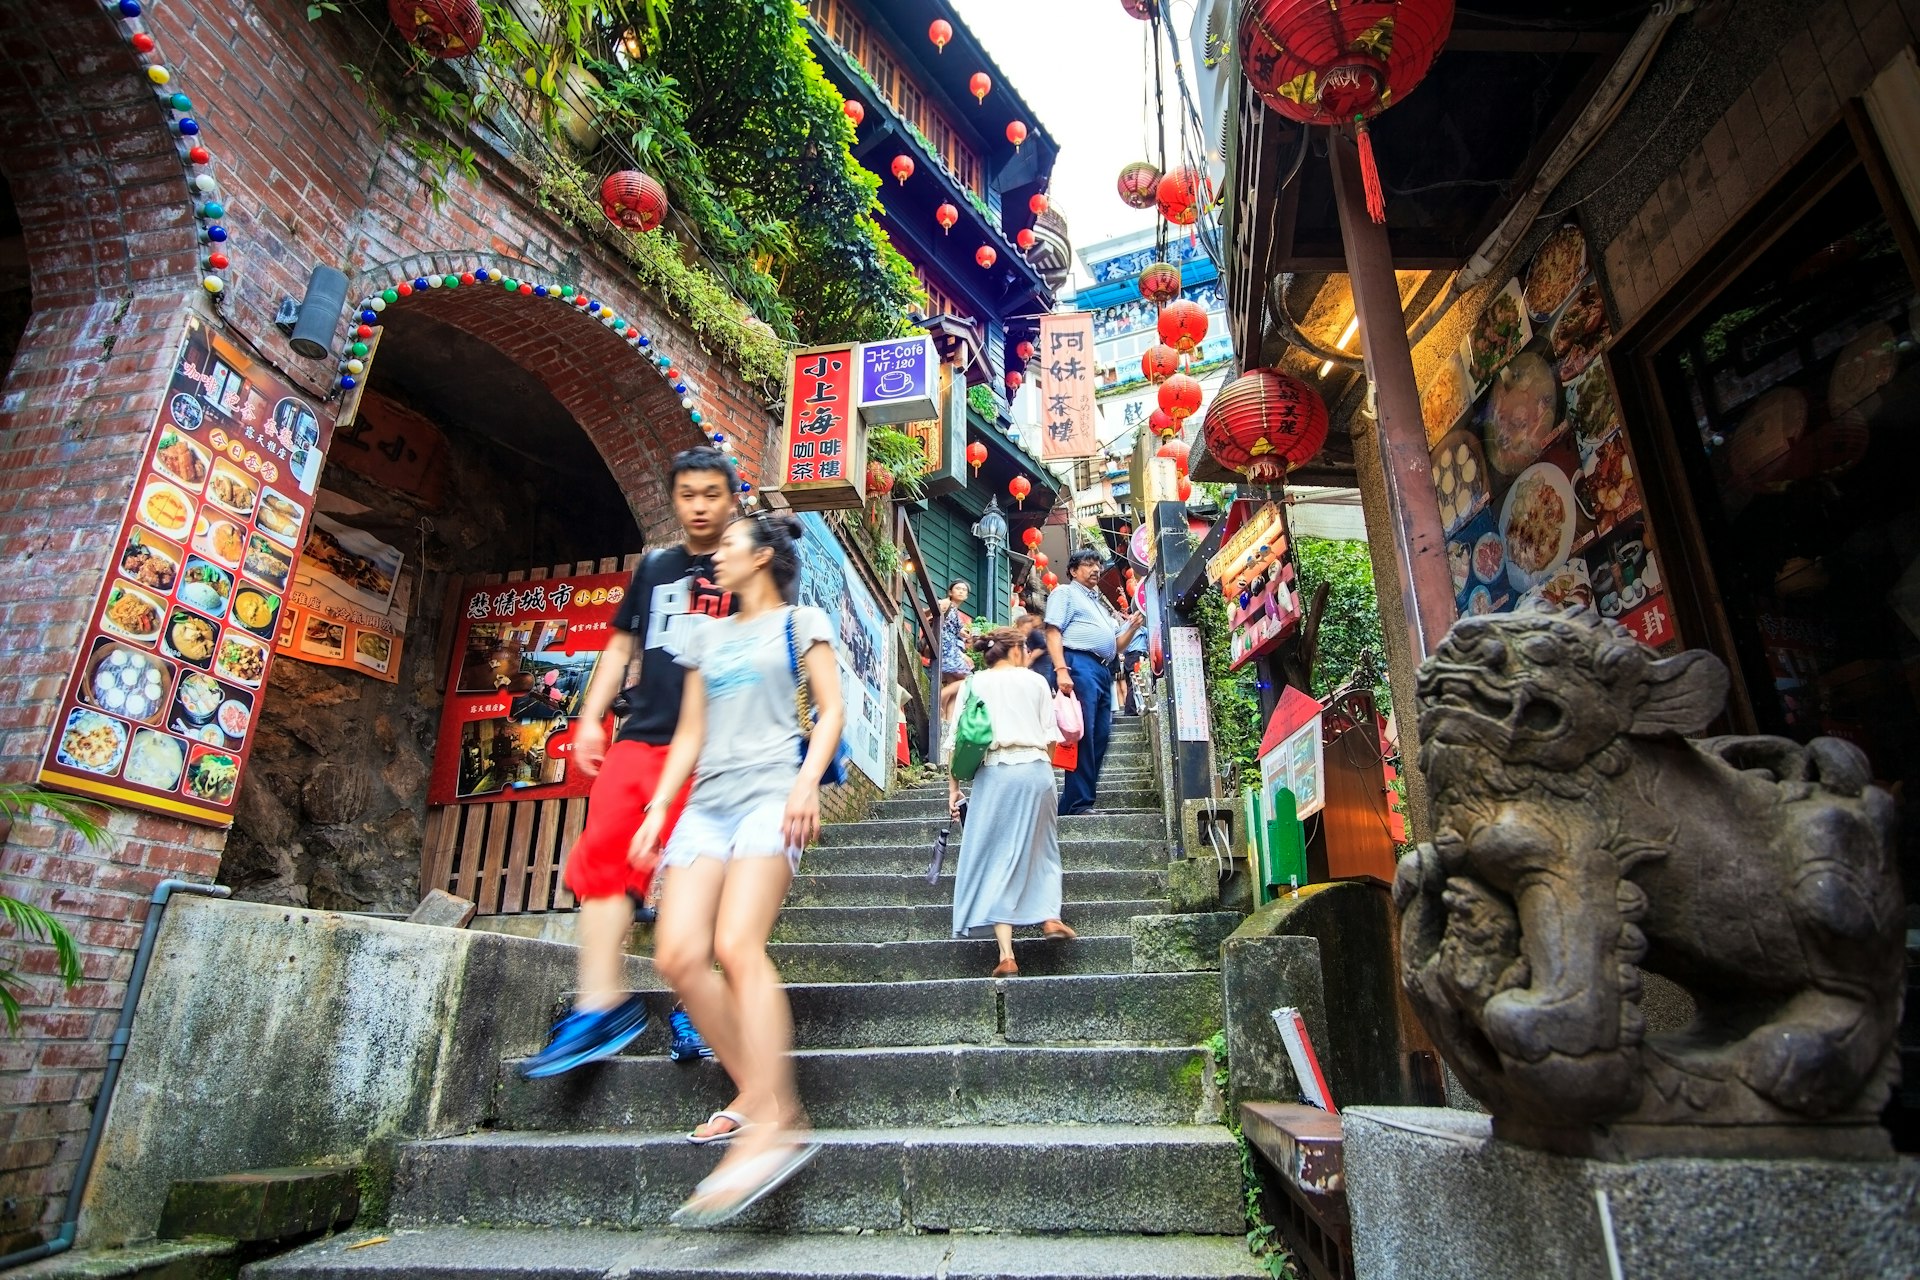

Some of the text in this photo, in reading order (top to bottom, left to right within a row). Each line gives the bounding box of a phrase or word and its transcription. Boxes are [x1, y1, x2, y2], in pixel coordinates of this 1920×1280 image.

[799, 356, 843, 436] 小上海
[245, 425, 287, 461] 露天雅座
[467, 583, 574, 619] 悲情城市
